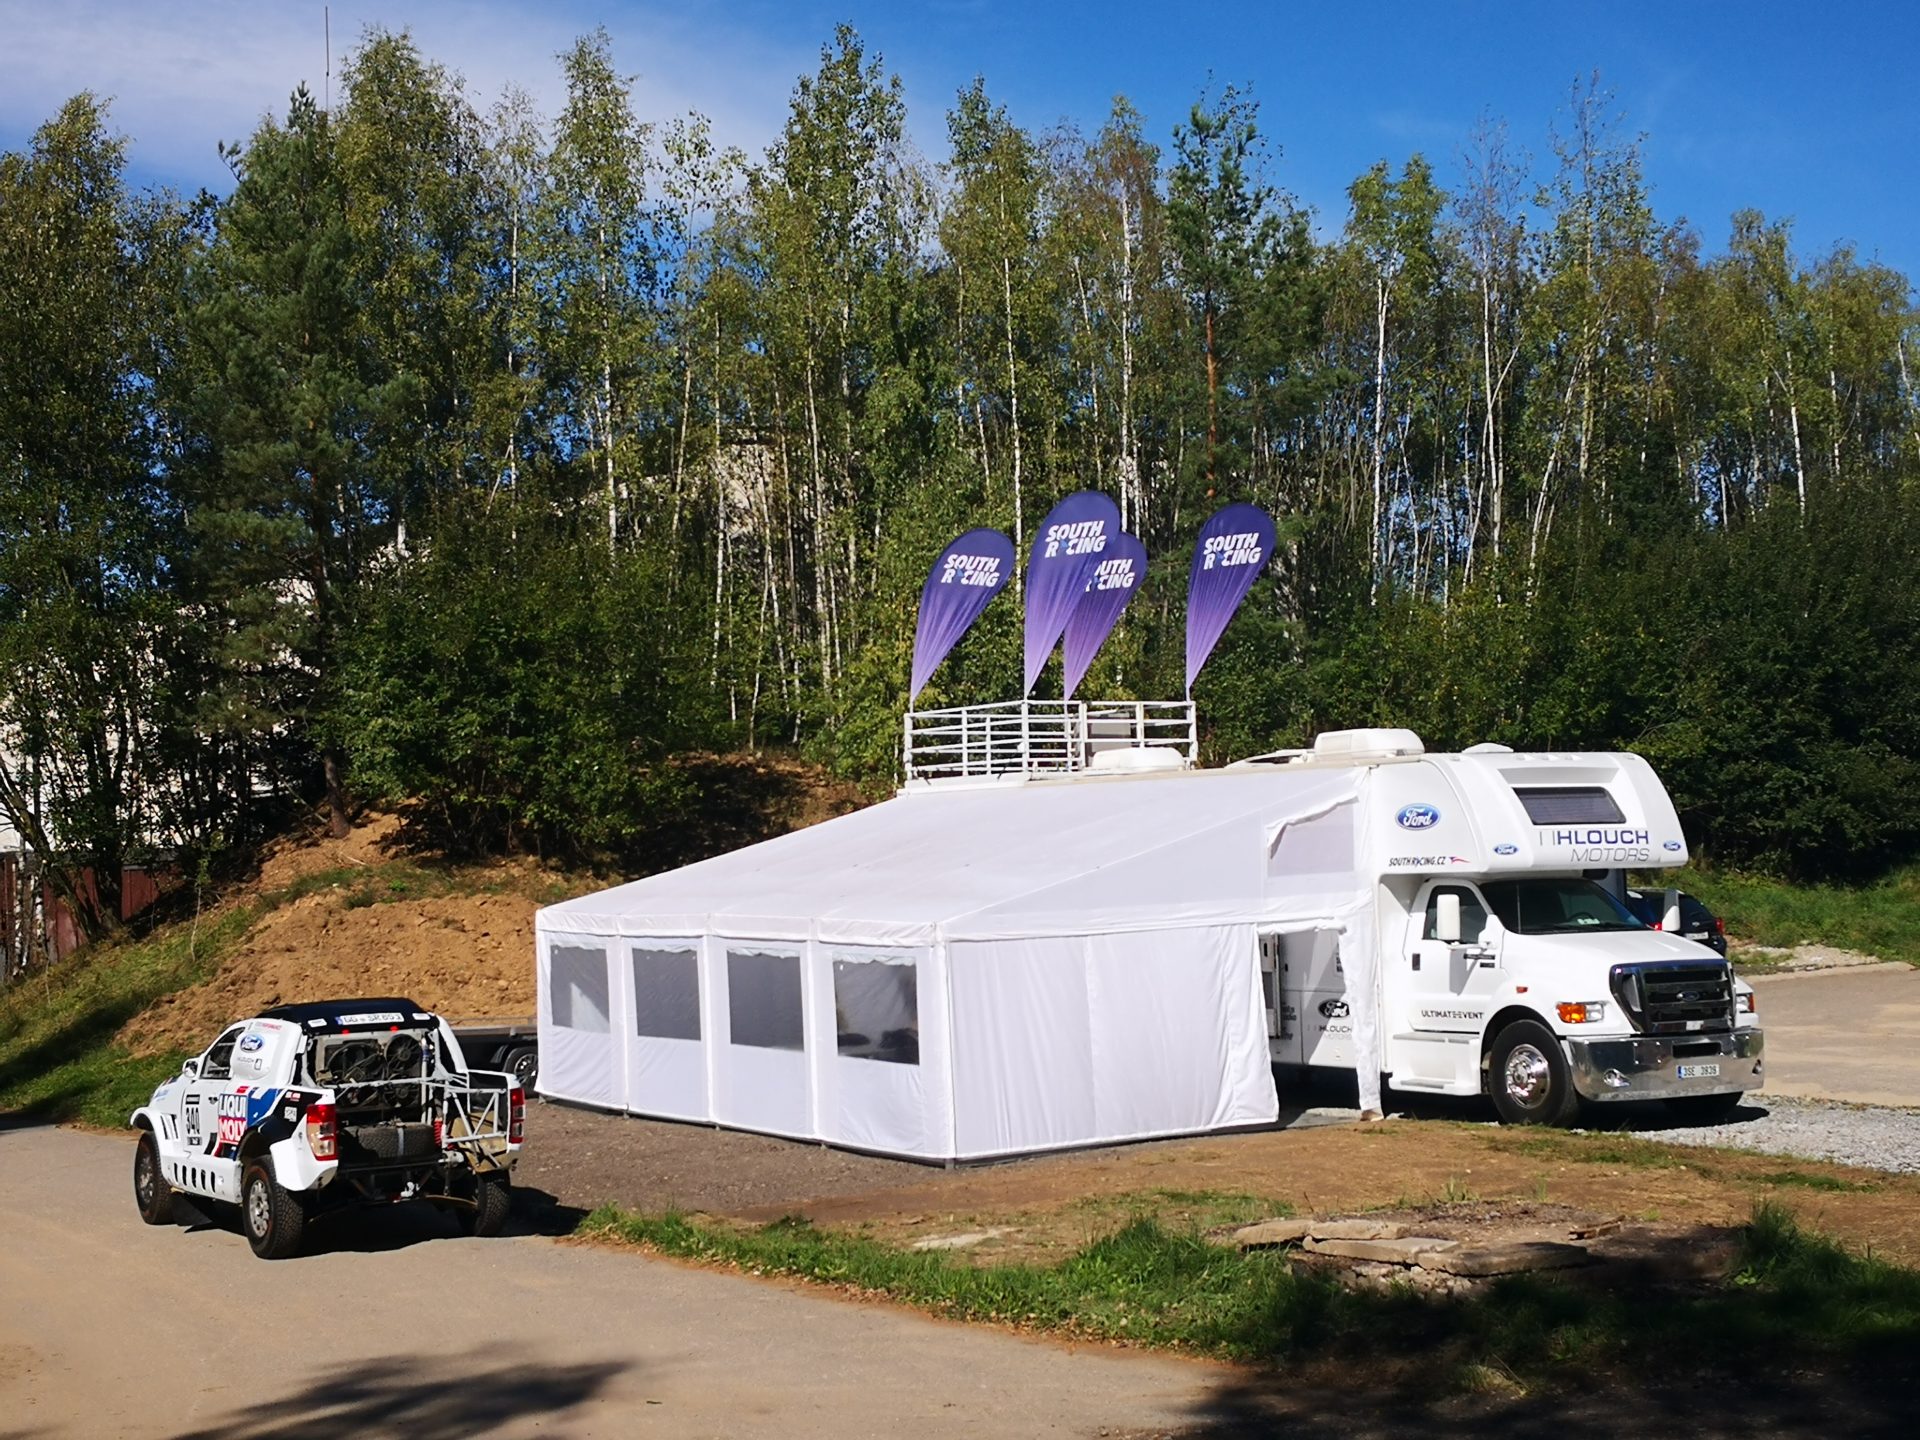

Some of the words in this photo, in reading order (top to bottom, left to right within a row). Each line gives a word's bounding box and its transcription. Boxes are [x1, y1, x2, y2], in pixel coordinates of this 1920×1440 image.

[1045, 520, 1105, 542] SOUTH
[1203, 532, 1259, 555] SOUTH
[943, 554, 1000, 572] SOUTH
[1094, 559, 1133, 576] UTH
[1403, 807, 1433, 827] Ford
[1557, 830, 1649, 845] HLOUCH
[1571, 848, 1650, 862] MOTORS
[218, 1094, 247, 1118] LIQUI
[186, 1107, 200, 1135] 340
[218, 1117, 247, 1142] MOLY
